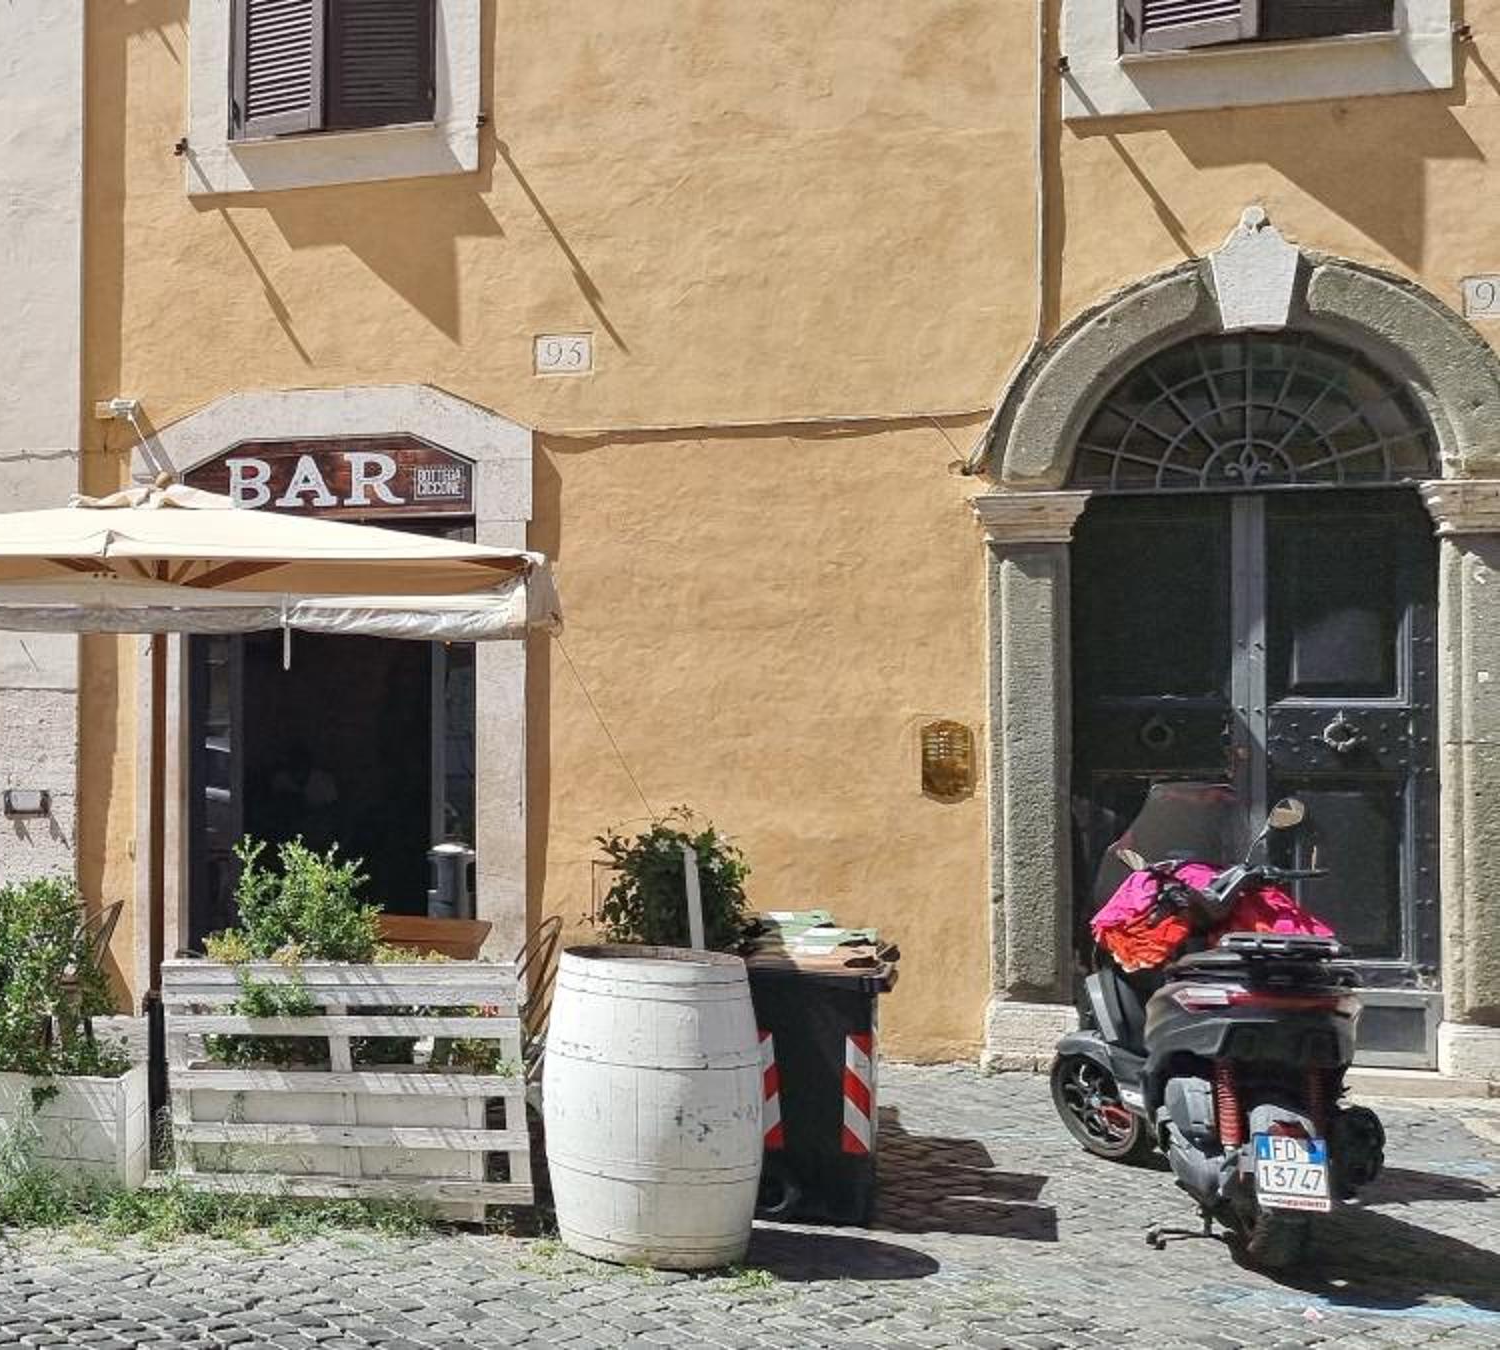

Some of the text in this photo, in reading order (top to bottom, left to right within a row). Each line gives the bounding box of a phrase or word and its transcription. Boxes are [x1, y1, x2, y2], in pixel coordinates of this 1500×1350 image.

[546, 341, 582, 367] 95
[225, 451, 406, 509] BAR
[1262, 1165, 1323, 1191] 13747
